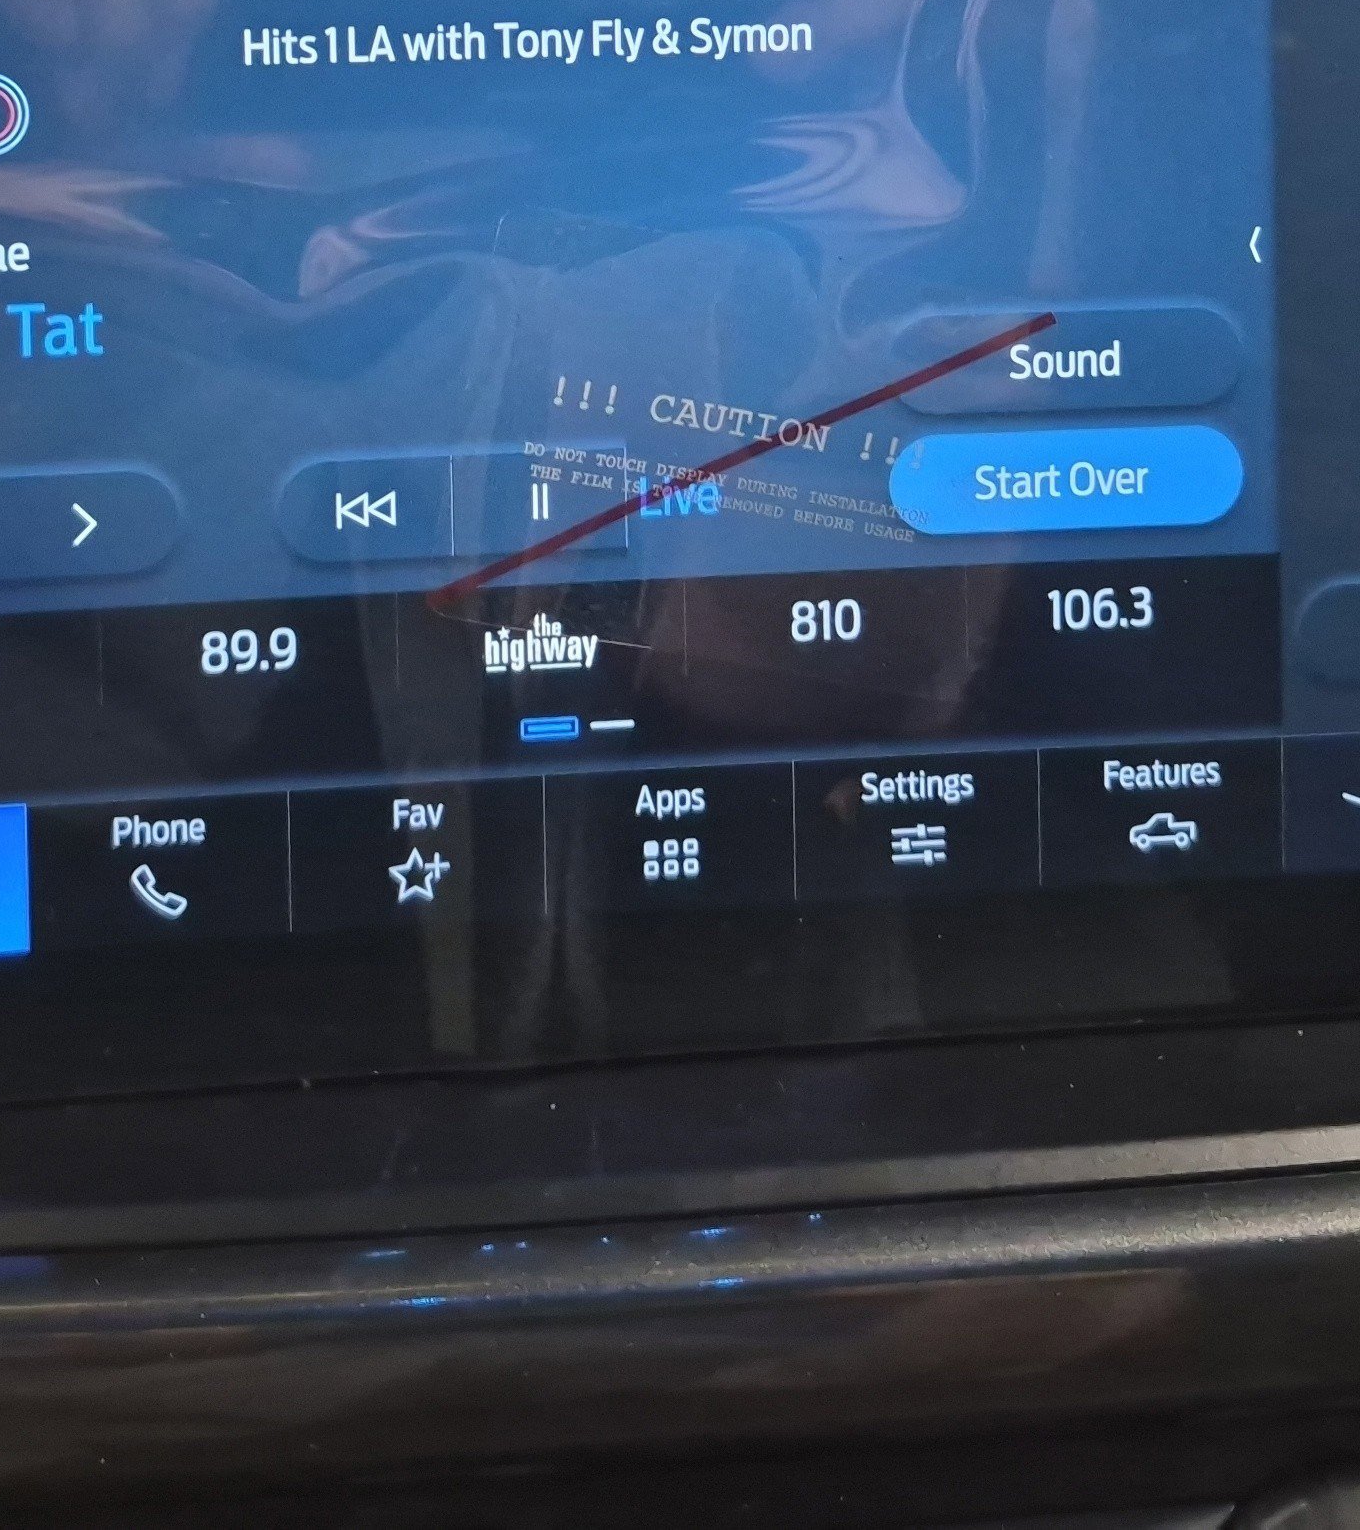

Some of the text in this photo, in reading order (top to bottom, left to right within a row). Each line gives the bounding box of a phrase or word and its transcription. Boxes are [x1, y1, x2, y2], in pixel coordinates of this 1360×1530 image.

[243, 26, 316, 66] Hits
[346, 25, 396, 64] LA
[403, 22, 486, 62] with
[494, 21, 583, 65] Tony
[592, 18, 645, 63] Fly
[651, 17, 681, 56] &
[689, 16, 812, 65] Symon
[6, 303, 105, 360] Tat
[1008, 340, 1122, 380] Sound
[650, 394, 832, 452] CAUTION
[524, 441, 930, 525] DO NOT TOUCH DISPLAY DURING INSTALLATION
[639, 475, 721, 517] Live
[974, 461, 1149, 502] Start Over
[530, 464, 562, 482] THE
[570, 471, 614, 490] FILM
[622, 479, 641, 494] IS
[794, 509, 854, 532] BEFORE
[864, 521, 915, 543] USAGE
[533, 613, 562, 636] the
[790, 598, 862, 643] 810
[1047, 585, 1154, 632] 106.3
[200, 626, 299, 675] 89.9
[483, 630, 599, 670] highway
[860, 769, 975, 806] Settings
[1103, 758, 1222, 792] Features
[392, 798, 444, 831] Fav
[634, 783, 706, 821] Apps
[111, 813, 207, 849] Phone
